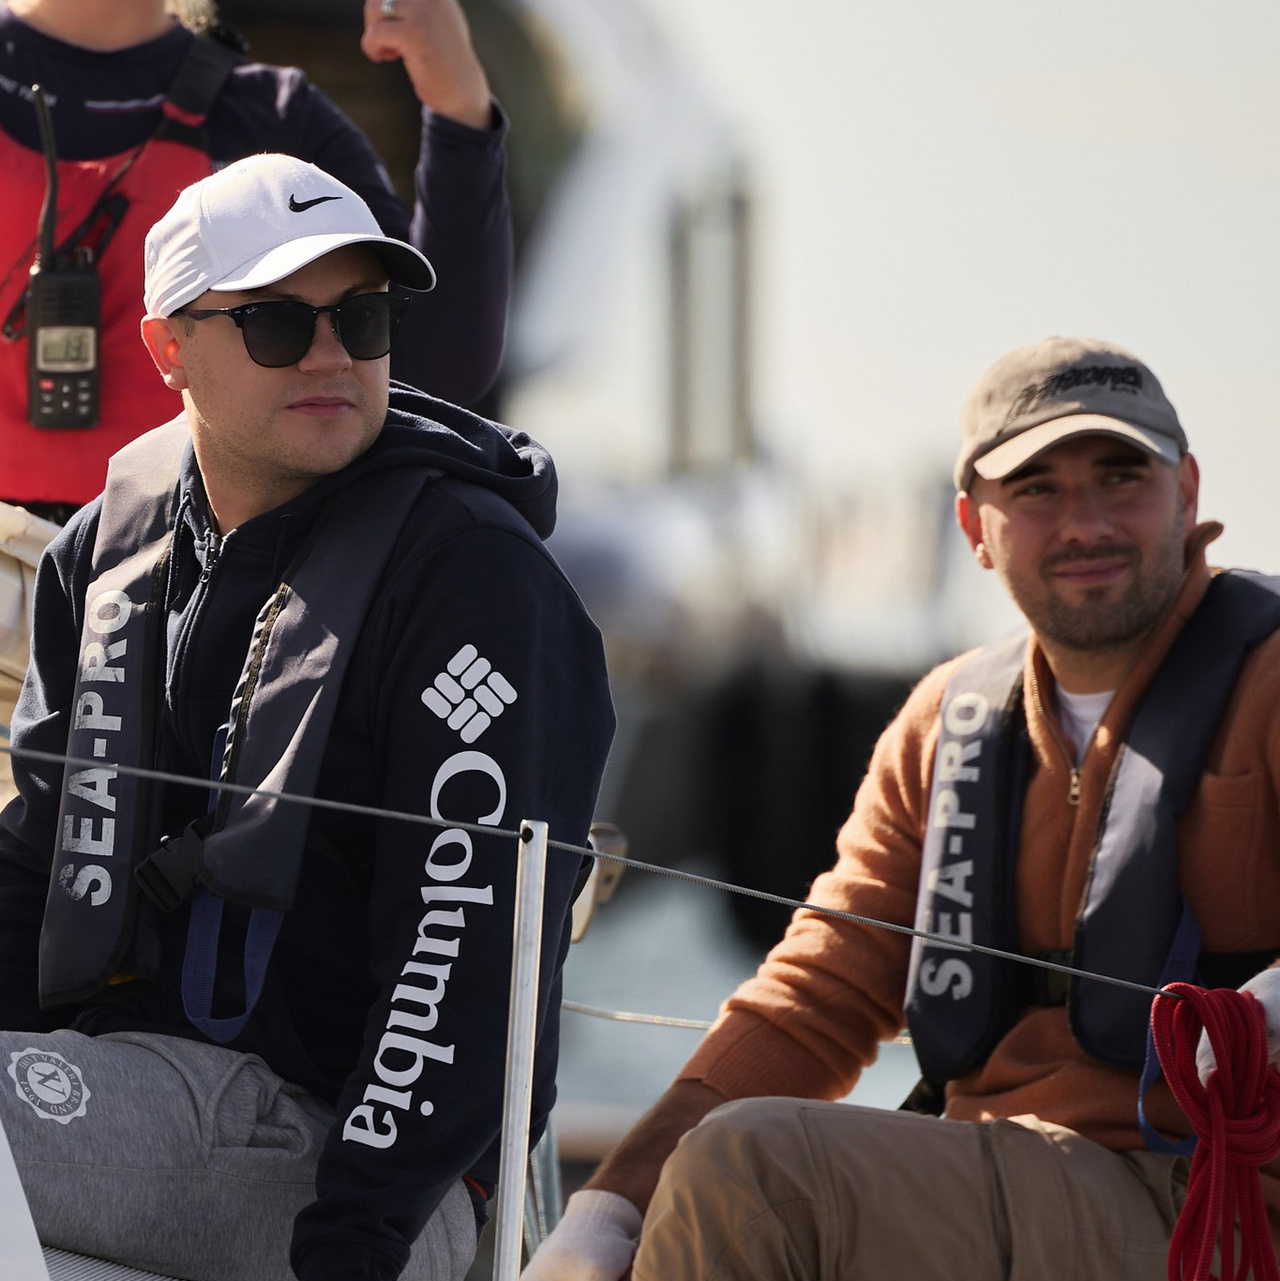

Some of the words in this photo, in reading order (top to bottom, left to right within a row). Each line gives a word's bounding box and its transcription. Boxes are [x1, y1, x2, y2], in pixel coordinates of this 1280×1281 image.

[58, 589, 133, 907] SEA-PRO
[921, 691, 990, 1001] SEA-PRO
[341, 750, 508, 1150] Columbia
